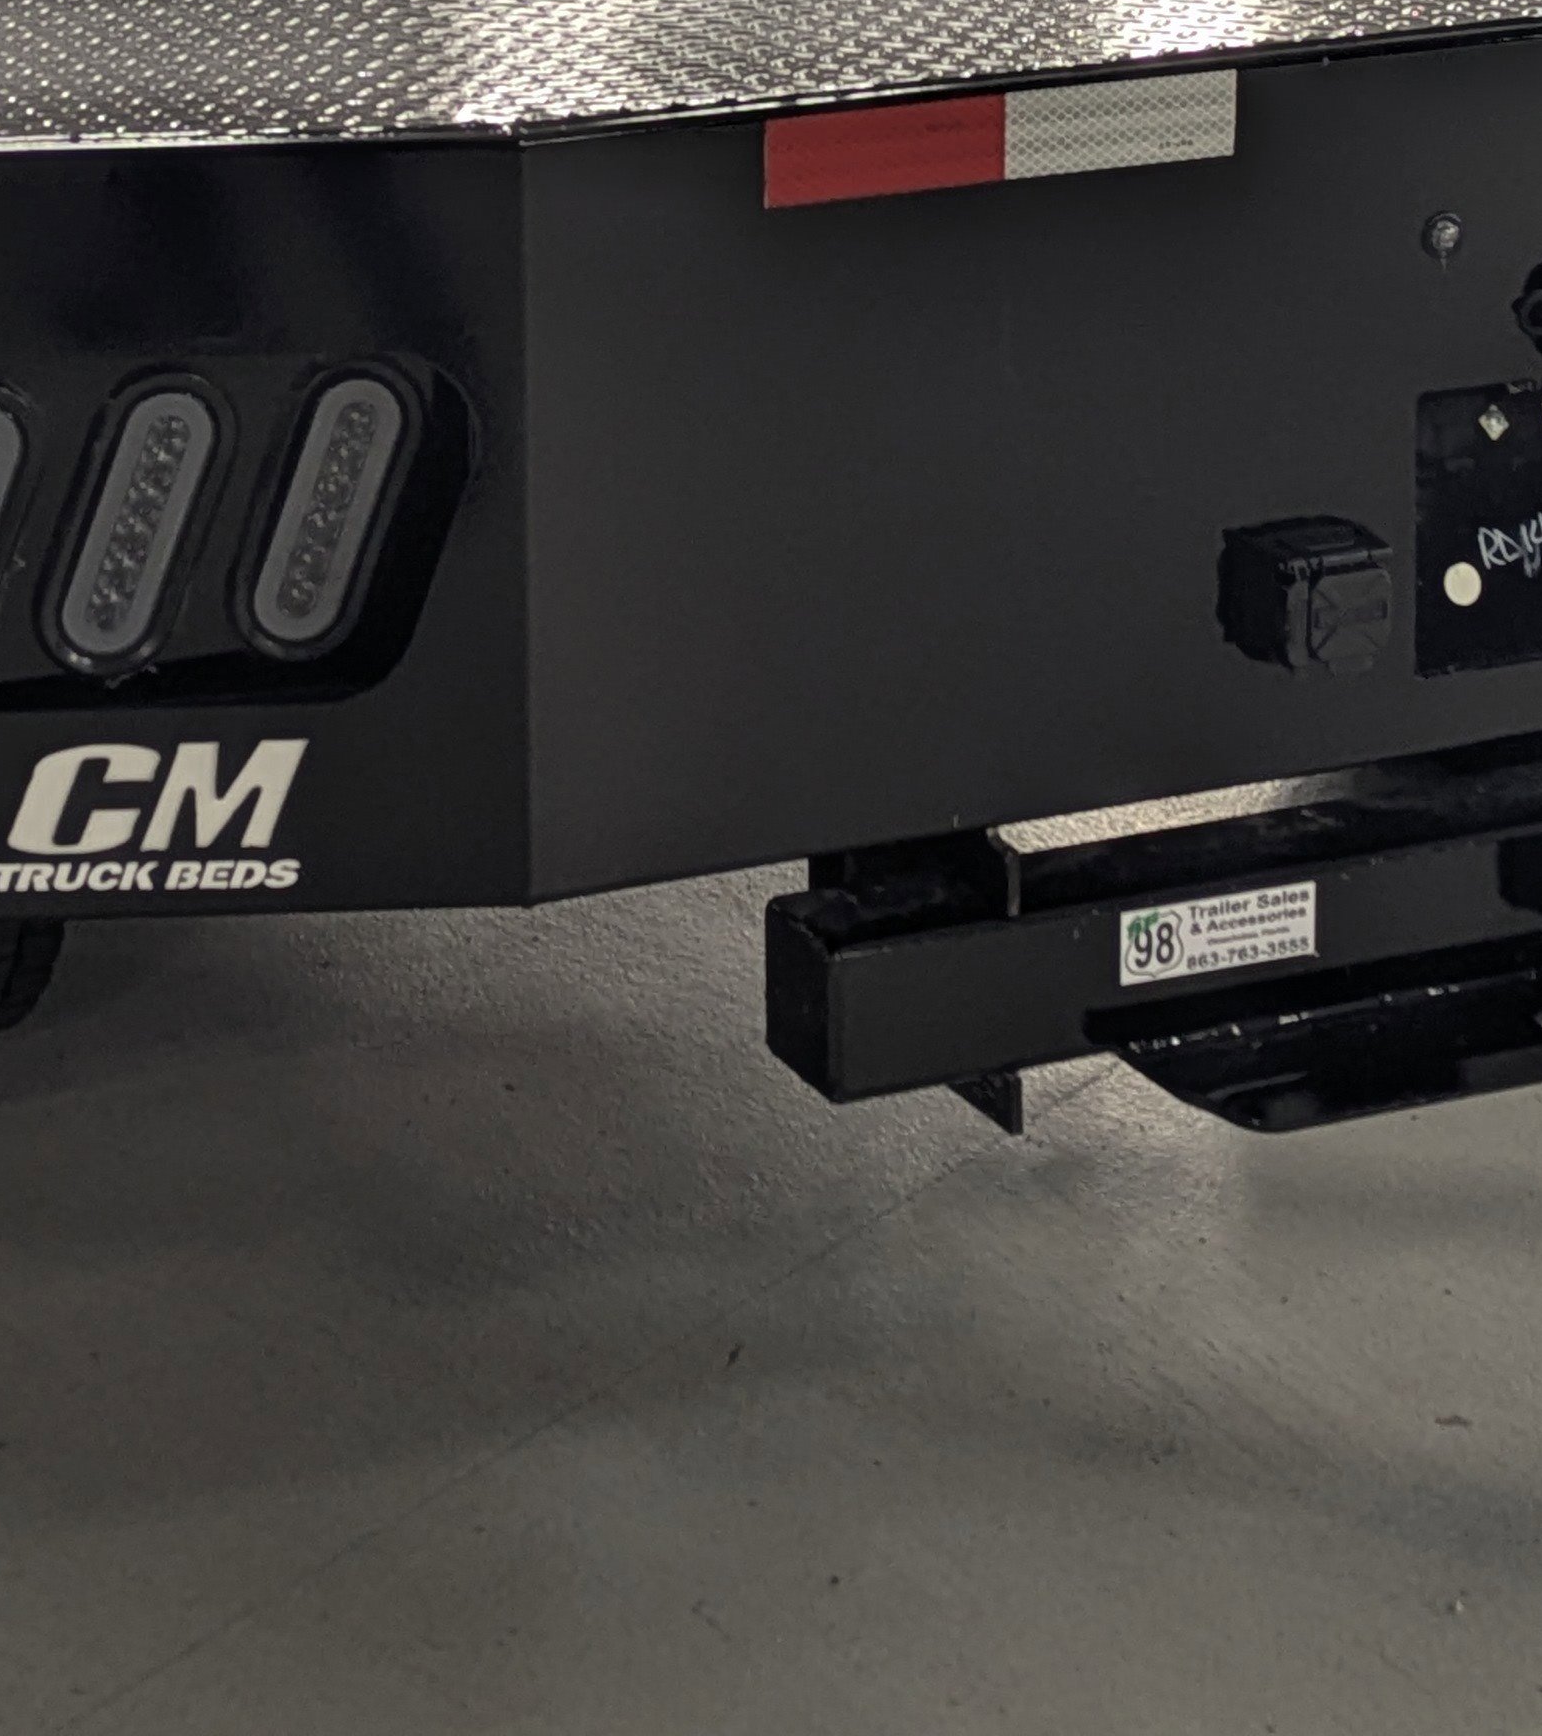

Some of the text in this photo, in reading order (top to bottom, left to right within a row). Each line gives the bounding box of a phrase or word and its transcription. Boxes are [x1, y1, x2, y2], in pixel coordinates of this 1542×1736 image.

[7, 738, 310, 855] CM
[165, 859, 301, 891] BEDS
[1189, 889, 1310, 920] Trailer Sales
[1190, 922, 1202, 936] &
[1207, 908, 1306, 932] Accessories
[1134, 921, 1174, 969] 98
